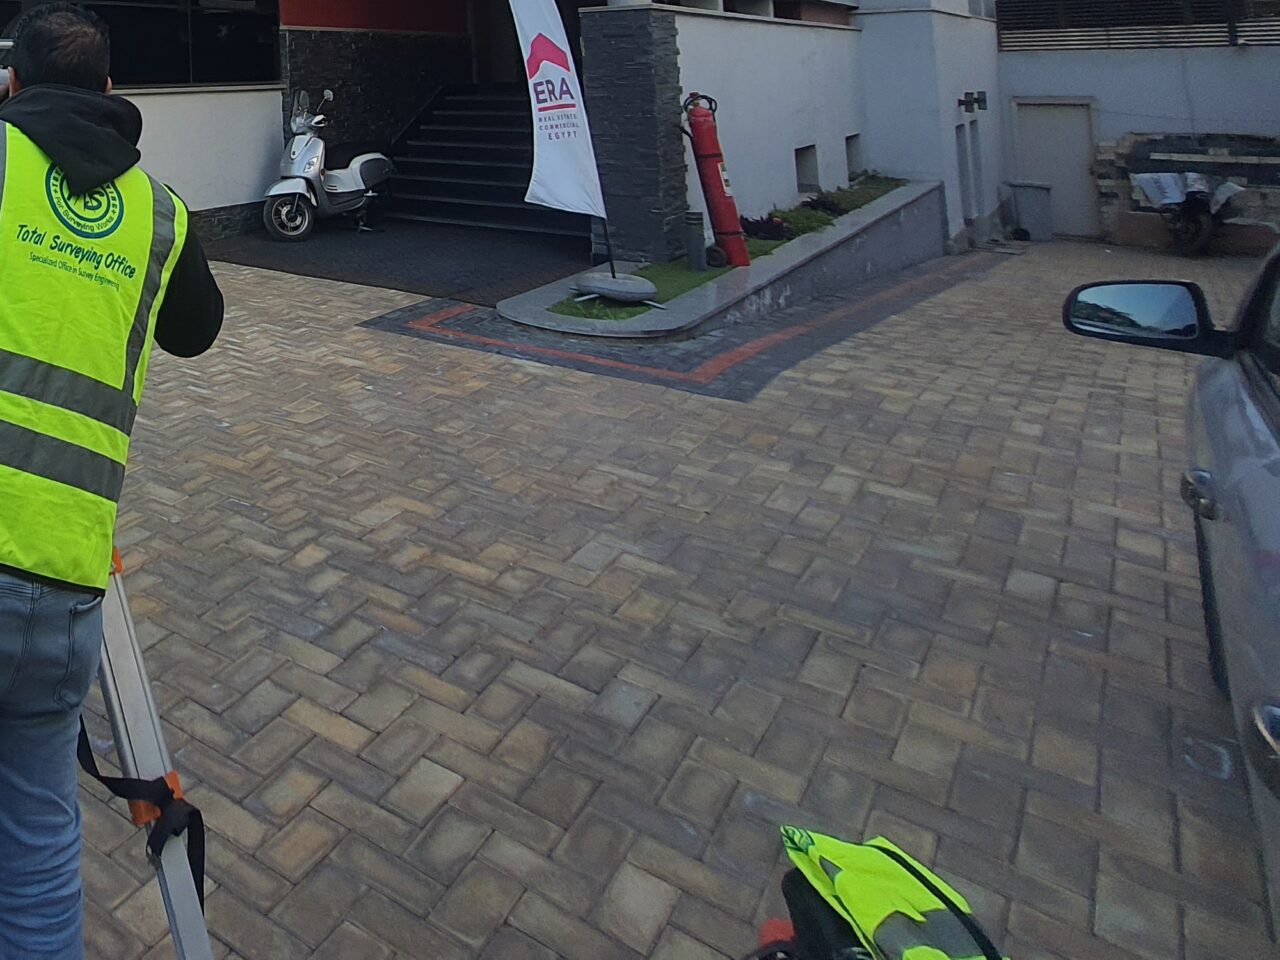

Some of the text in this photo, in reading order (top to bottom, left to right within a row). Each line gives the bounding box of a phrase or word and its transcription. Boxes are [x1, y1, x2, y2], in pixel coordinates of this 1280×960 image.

[533, 77, 575, 104] ERA
[548, 131, 577, 141] EGYPT
[62, 208, 96, 233] Surveying
[16, 224, 137, 279] Total Surveying Office
[29, 252, 58, 269] Specialized
[58, 260, 73, 273] Office
[78, 267, 94, 281] Survey
